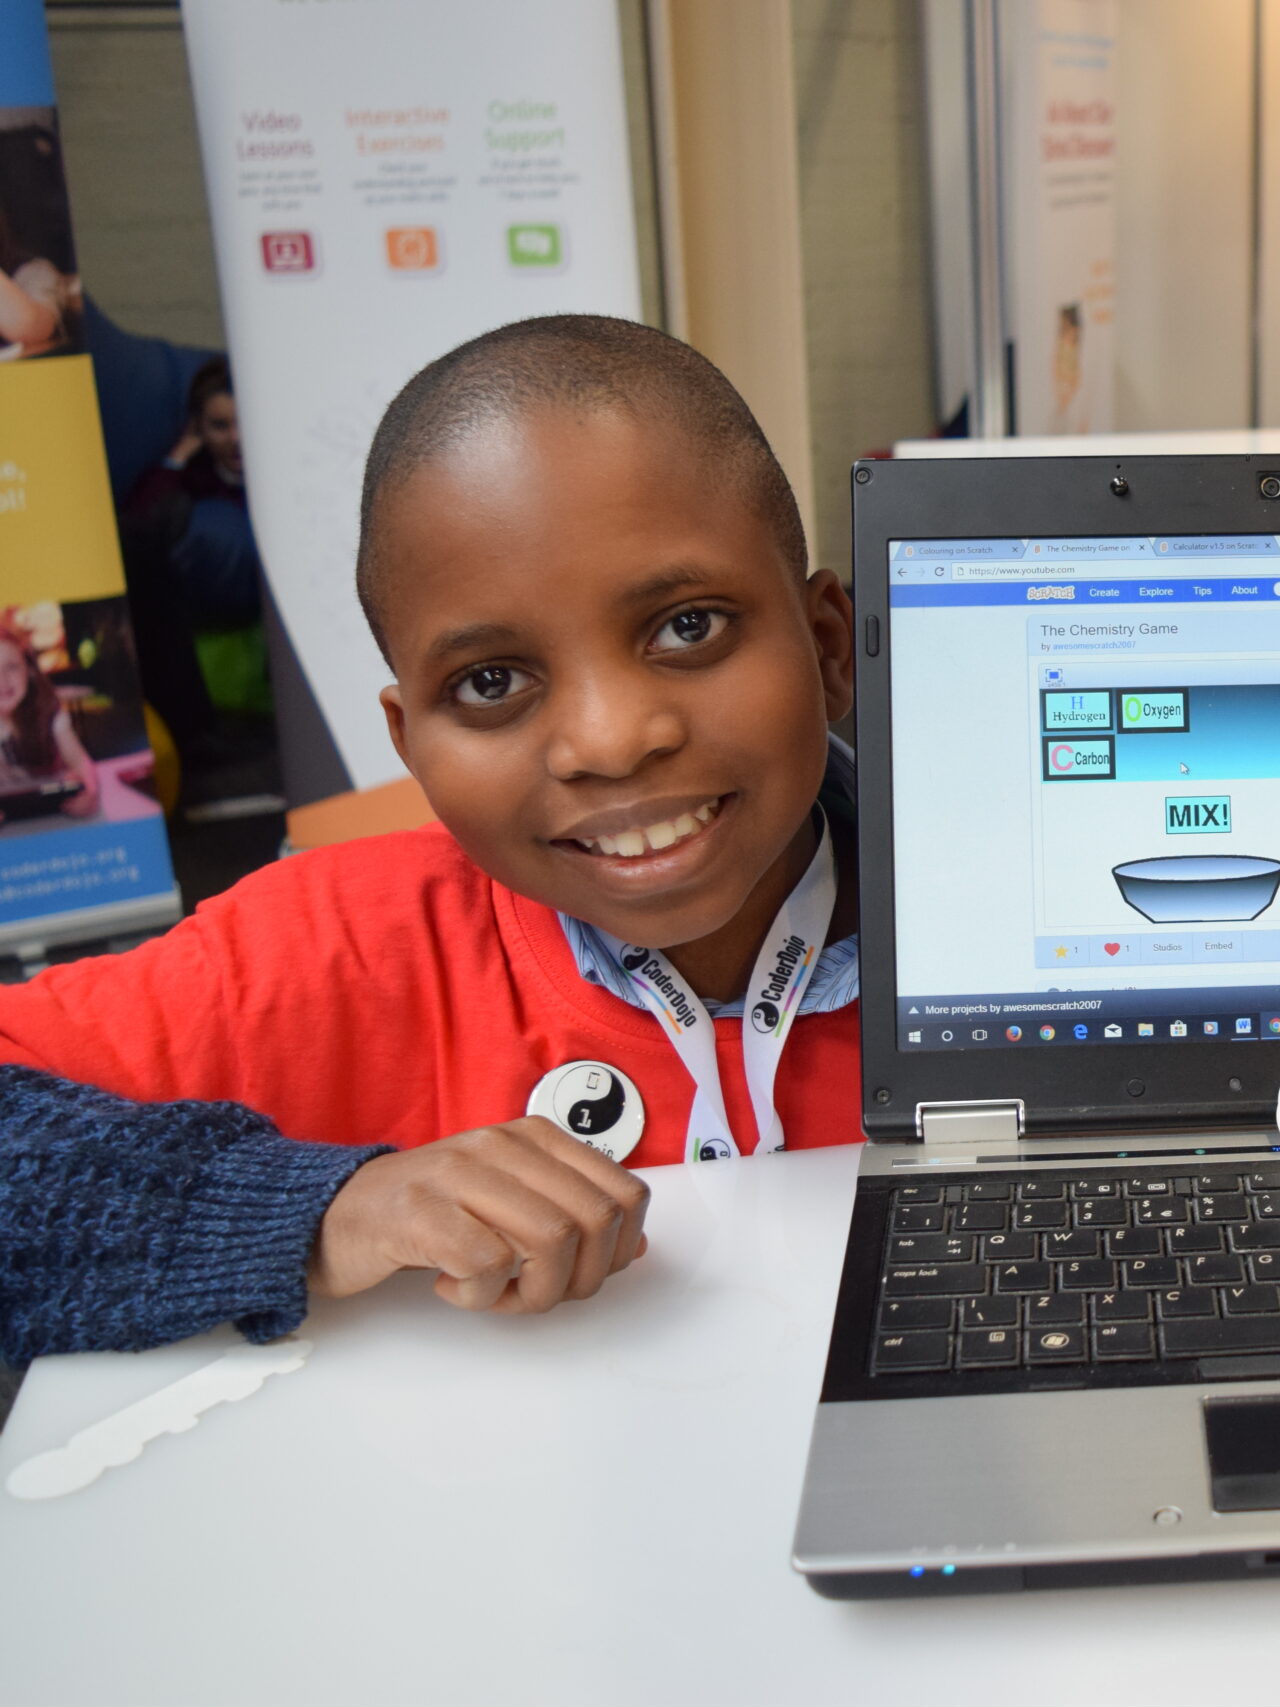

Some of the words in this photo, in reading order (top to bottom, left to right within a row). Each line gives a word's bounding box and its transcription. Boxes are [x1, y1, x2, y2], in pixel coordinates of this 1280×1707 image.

[346, 106, 450, 127] Interactive
[243, 111, 301, 133] Video
[357, 134, 446, 154] Exercises
[484, 127, 566, 152] Support
[237, 137, 315, 160] Lessons
[1060, 545, 1097, 553] Chemistry
[1173, 542, 1208, 551] Calculator
[1209, 542, 1224, 550] v1.5
[969, 565, 1075, 577] https://www.youtube.com
[1028, 586, 1075, 599] SCRATCH
[1090, 588, 1119, 597] Create
[1139, 587, 1174, 598] Explore
[1193, 586, 1212, 596] Tips
[1231, 585, 1258, 595] About
[1041, 624, 1065, 637] The
[1070, 623, 1135, 638] Chemistry
[1139, 623, 1178, 635] Game
[1041, 642, 1051, 651] by
[1053, 640, 1136, 650] awesomescratch2007
[1071, 696, 1084, 709] H
[1125, 697, 1142, 722] O
[1143, 704, 1181, 718] Oxygen
[1053, 711, 1106, 723] Hydrogen
[1051, 745, 1074, 771] C
[1075, 752, 1110, 766] Carbon
[1169, 804, 1229, 827] MIX!
[1153, 942, 1182, 952] Studios
[1205, 941, 1233, 951] Embed
[761, 935, 806, 1001] CoderDojo
[641, 959, 697, 1028] CoderDojo
[925, 1005, 949, 1014] More
[951, 1004, 988, 1015] projects
[989, 1003, 1000, 1014] by
[1003, 1000, 1102, 1013] awesomescratch2007
[1176, 1229, 1185, 1237] R
[1240, 1225, 1249, 1234] T
[989, 1235, 1005, 1245] Q
[1054, 1233, 1073, 1241] W
[1115, 1231, 1125, 1239] E
[1133, 1261, 1146, 1269] D
[1197, 1257, 1206, 1265] F
[1258, 1256, 1273, 1264] G
[1005, 1266, 1018, 1275] A
[1069, 1262, 1080, 1272] S
[893, 1270, 916, 1278] caps
[918, 1268, 938, 1277] lock
[1166, 1291, 1180, 1301] C
[1232, 1288, 1244, 1297] V
[1037, 1297, 1050, 1307] Z
[1102, 1294, 1115, 1303] X
[1102, 1327, 1117, 1335] alt
[884, 1337, 903, 1346] ctrl
